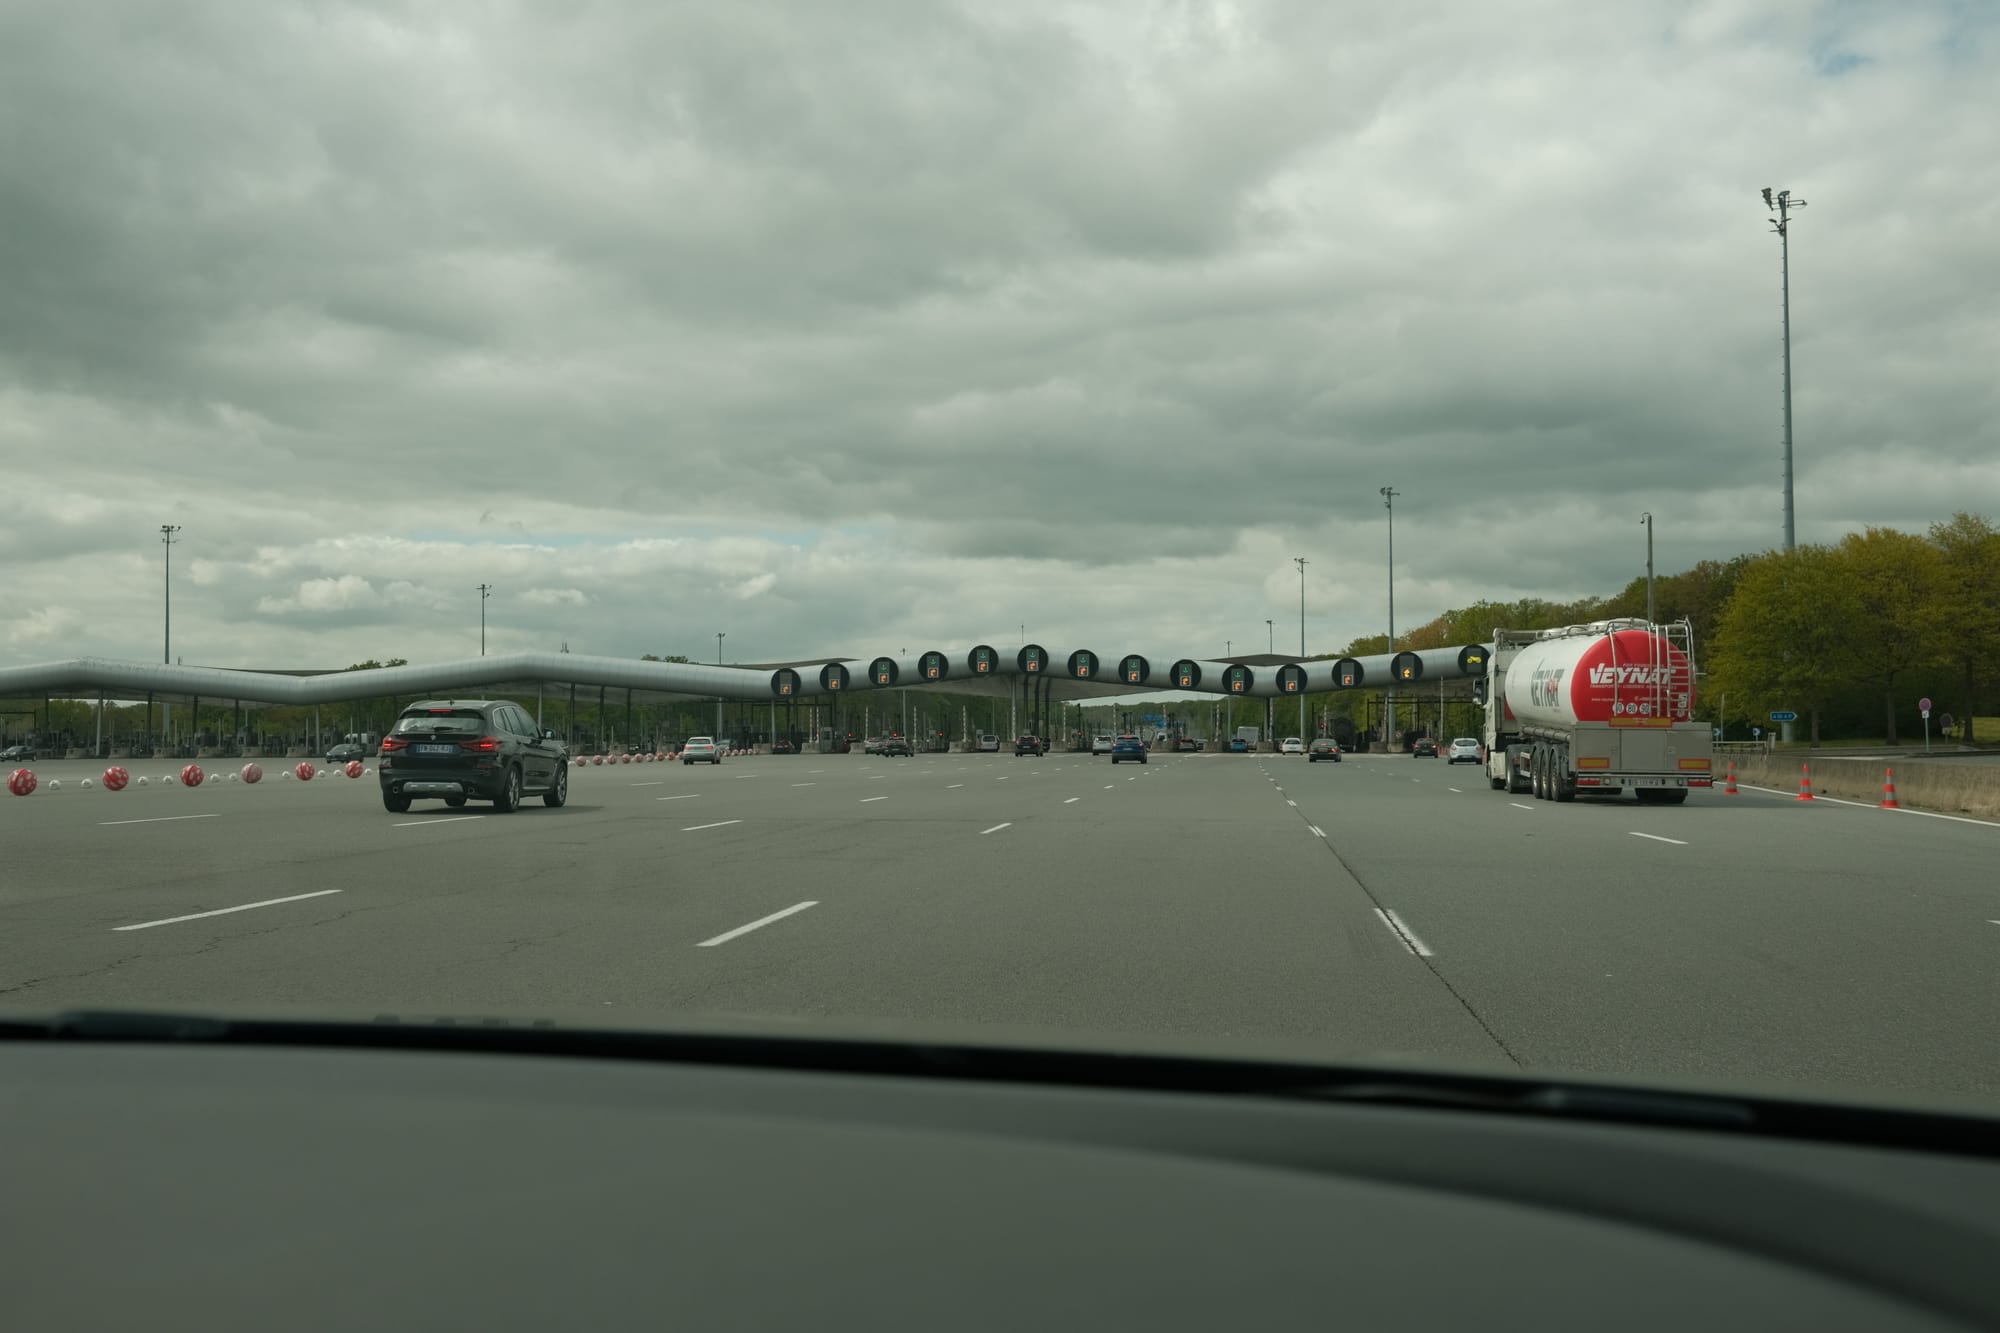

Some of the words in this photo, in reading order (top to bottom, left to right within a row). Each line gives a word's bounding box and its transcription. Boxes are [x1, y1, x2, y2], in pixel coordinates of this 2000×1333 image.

[1589, 663, 1677, 684] VEYNAT
[1628, 704, 1636, 712] 80
[1641, 704, 1649, 712] 90
